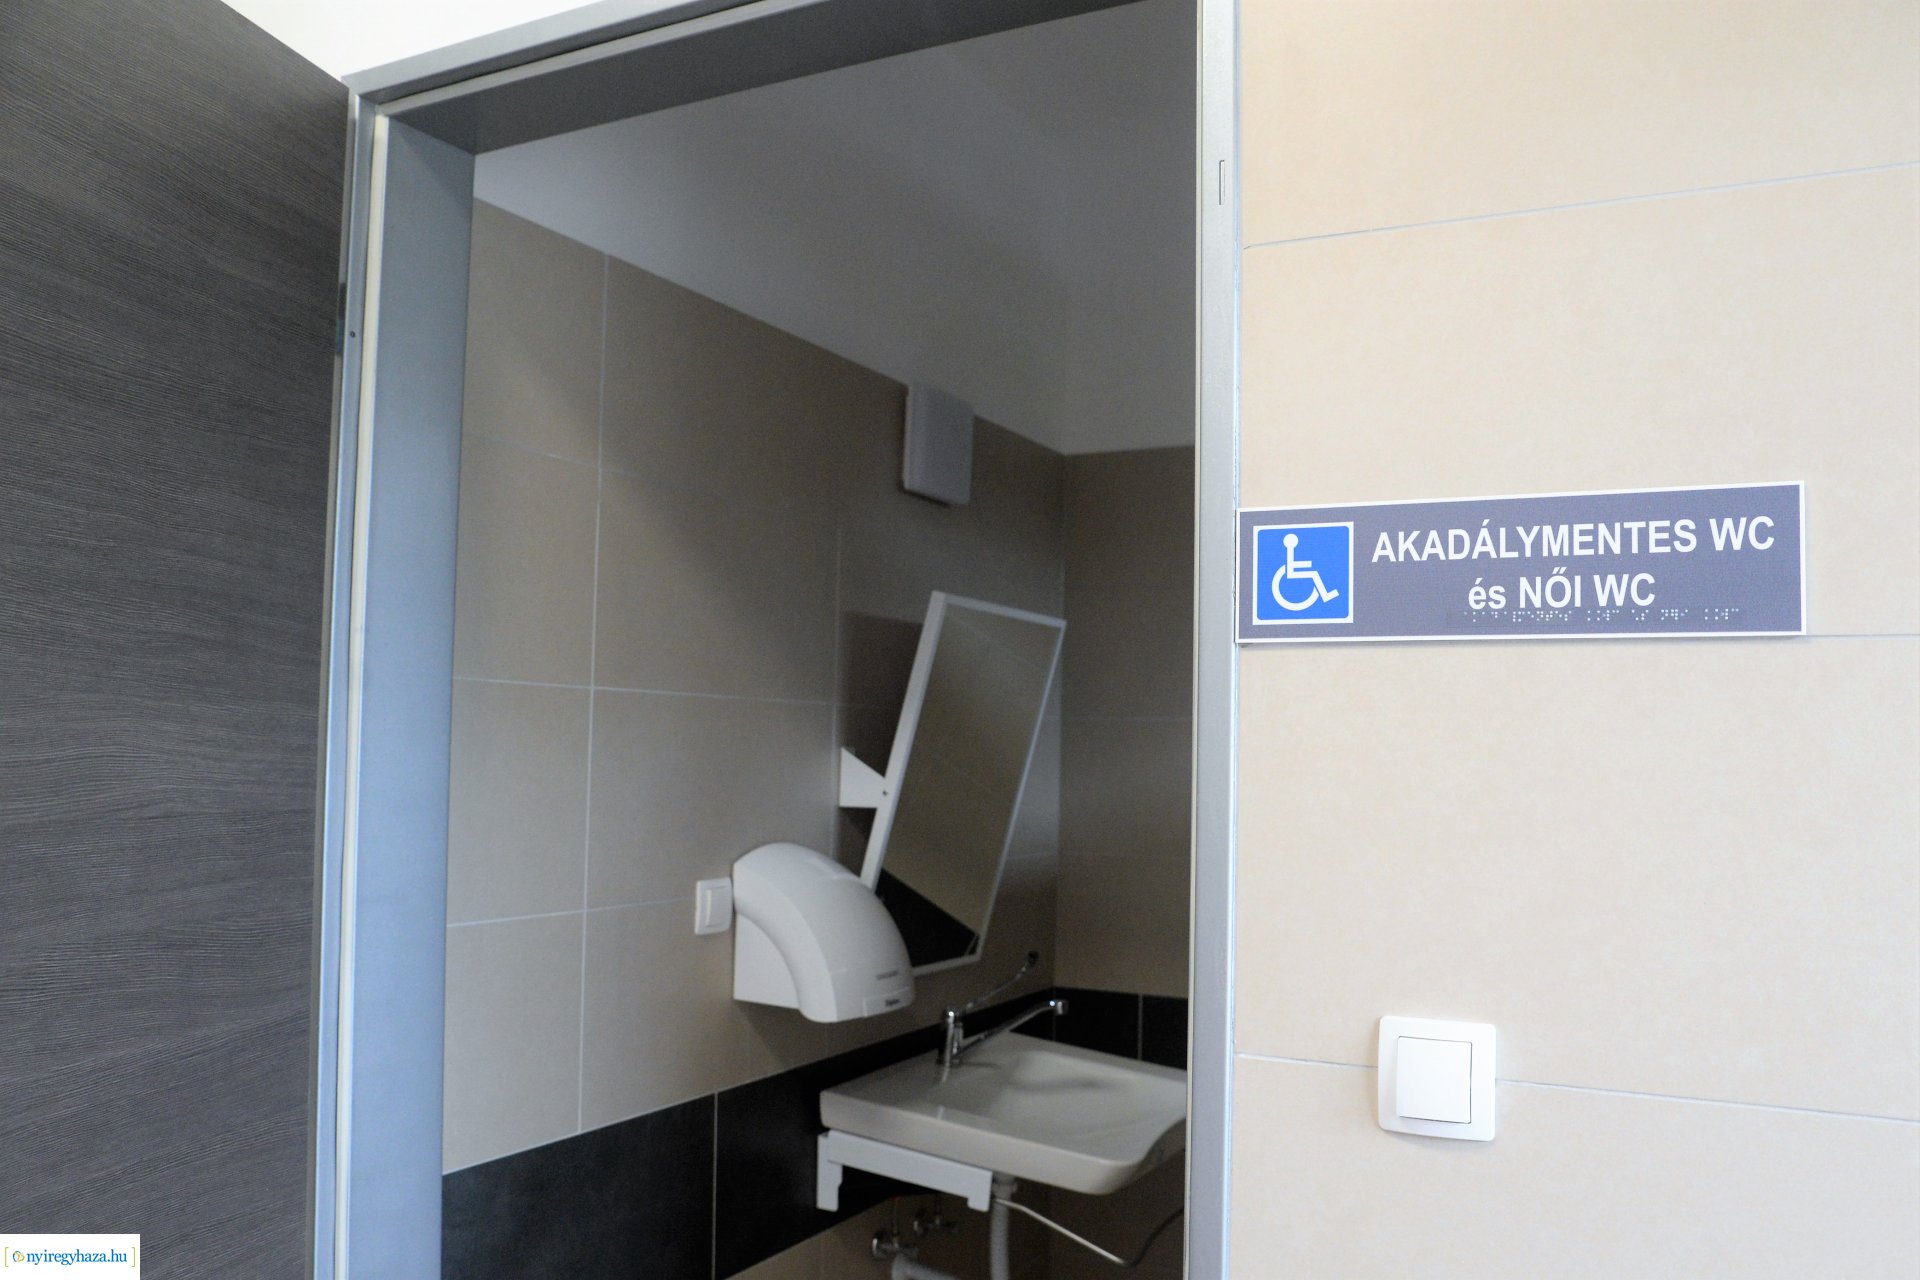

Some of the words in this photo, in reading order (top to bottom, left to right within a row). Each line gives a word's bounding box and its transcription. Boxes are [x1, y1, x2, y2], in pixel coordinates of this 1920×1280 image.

[1371, 519, 1697, 562] AKADÁLYMENTES
[1709, 516, 1775, 551] WC
[1468, 578, 1507, 610] és
[1518, 567, 1582, 609] NŐI
[1593, 573, 1656, 607] WC
